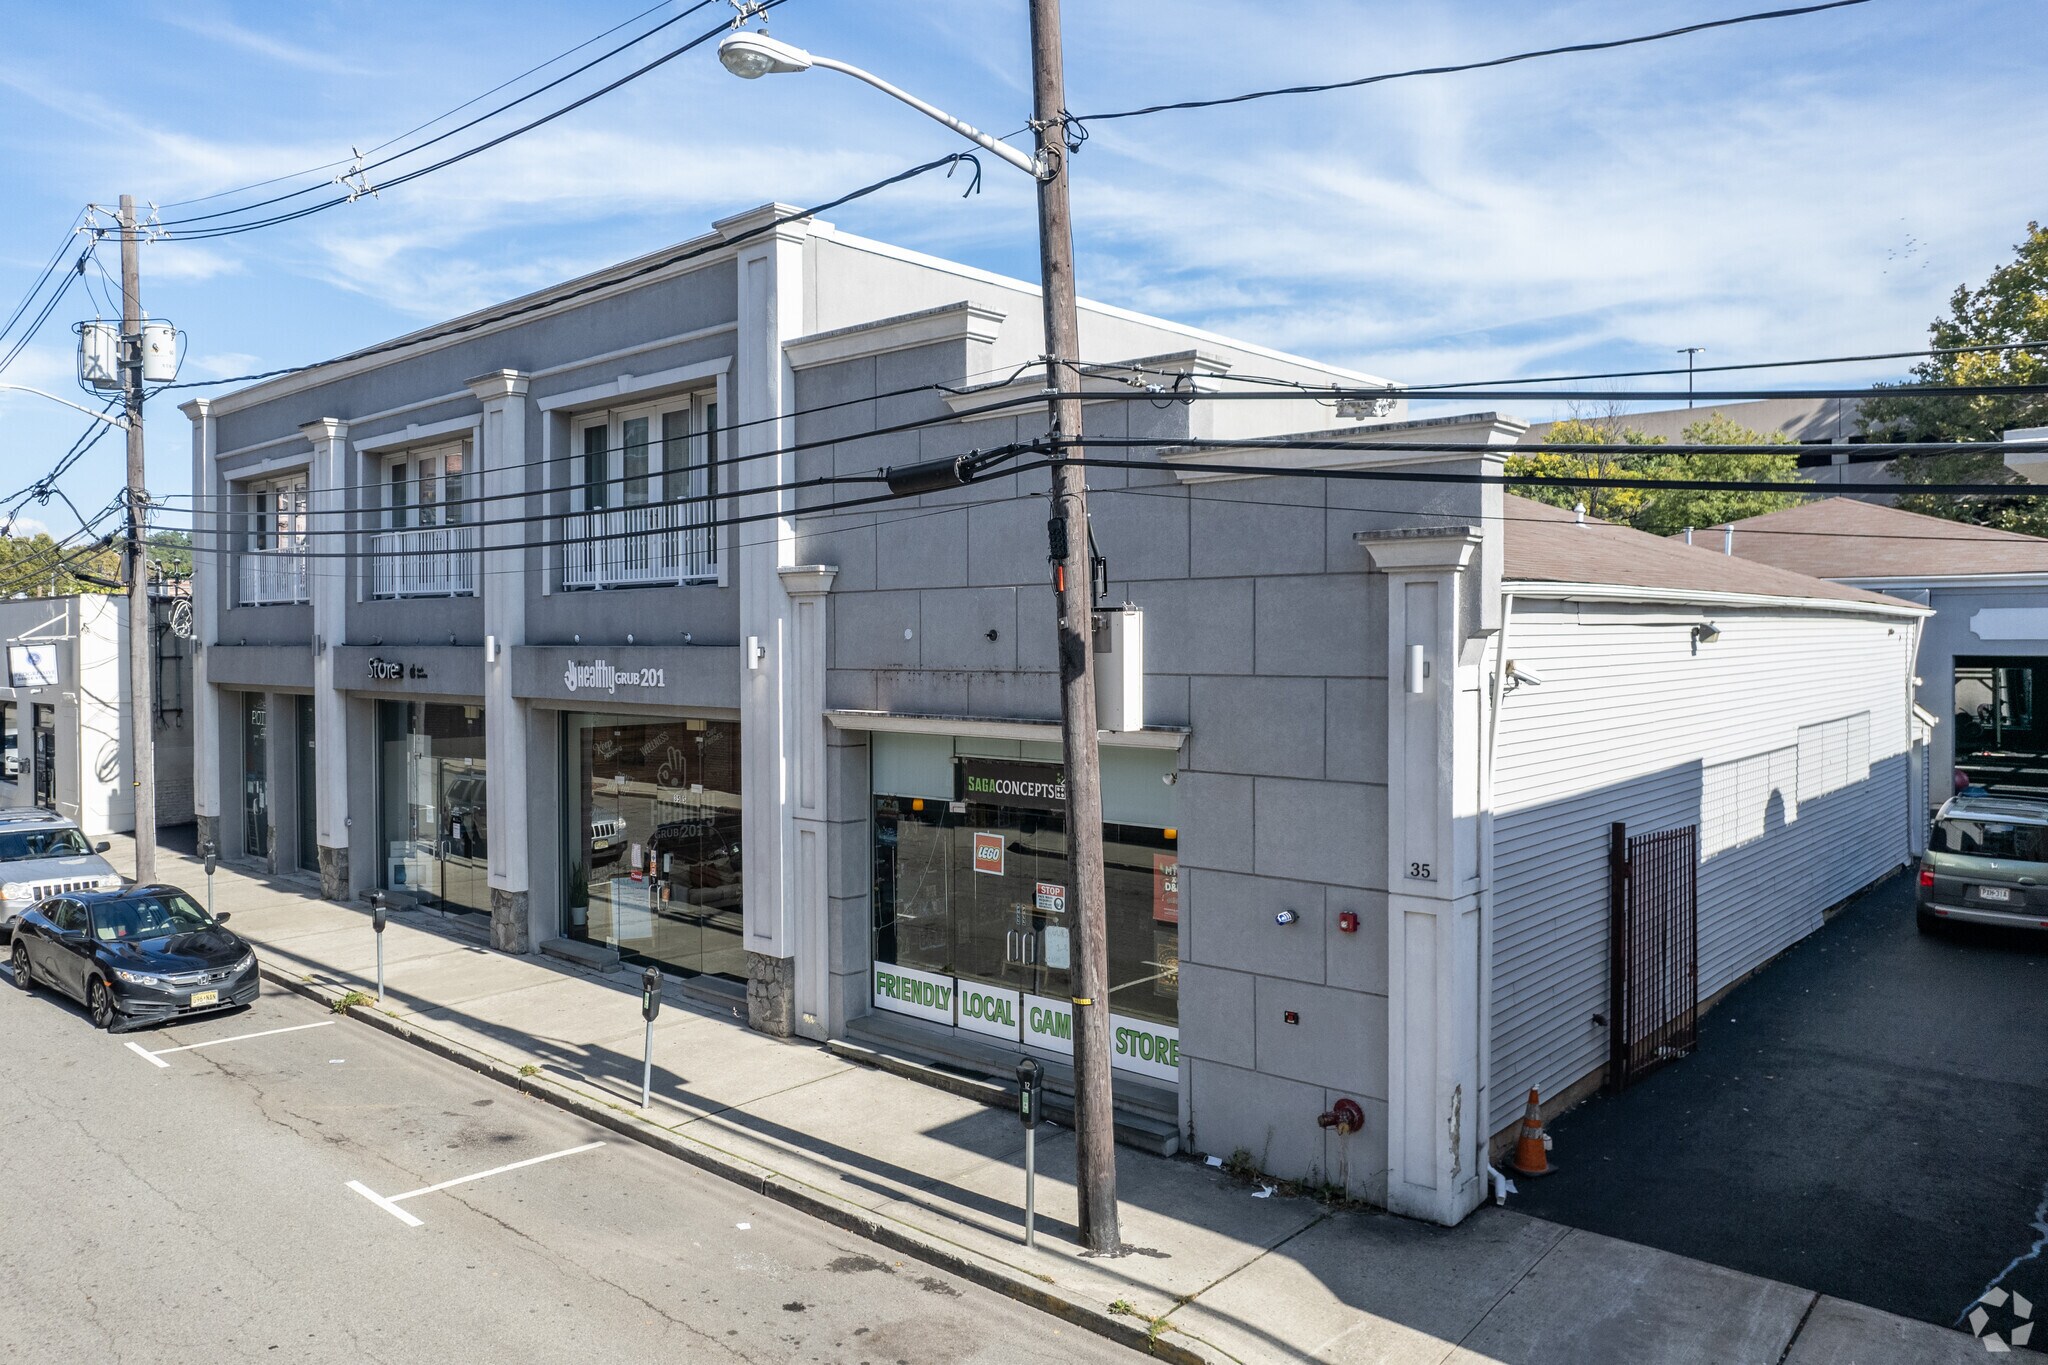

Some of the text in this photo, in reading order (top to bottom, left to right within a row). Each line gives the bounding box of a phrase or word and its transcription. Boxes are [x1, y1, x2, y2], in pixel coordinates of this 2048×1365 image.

[615, 672, 640, 685] GRUB
[640, 668, 665, 687] 201
[978, 846, 1000, 861] LEGO
[1411, 862, 1430, 878] 35
[1041, 885, 1060, 896] STOP
[1165, 882, 1178, 893] D&
[877, 971, 1178, 1067] FRIENDLY LOCAL GAM STORE
